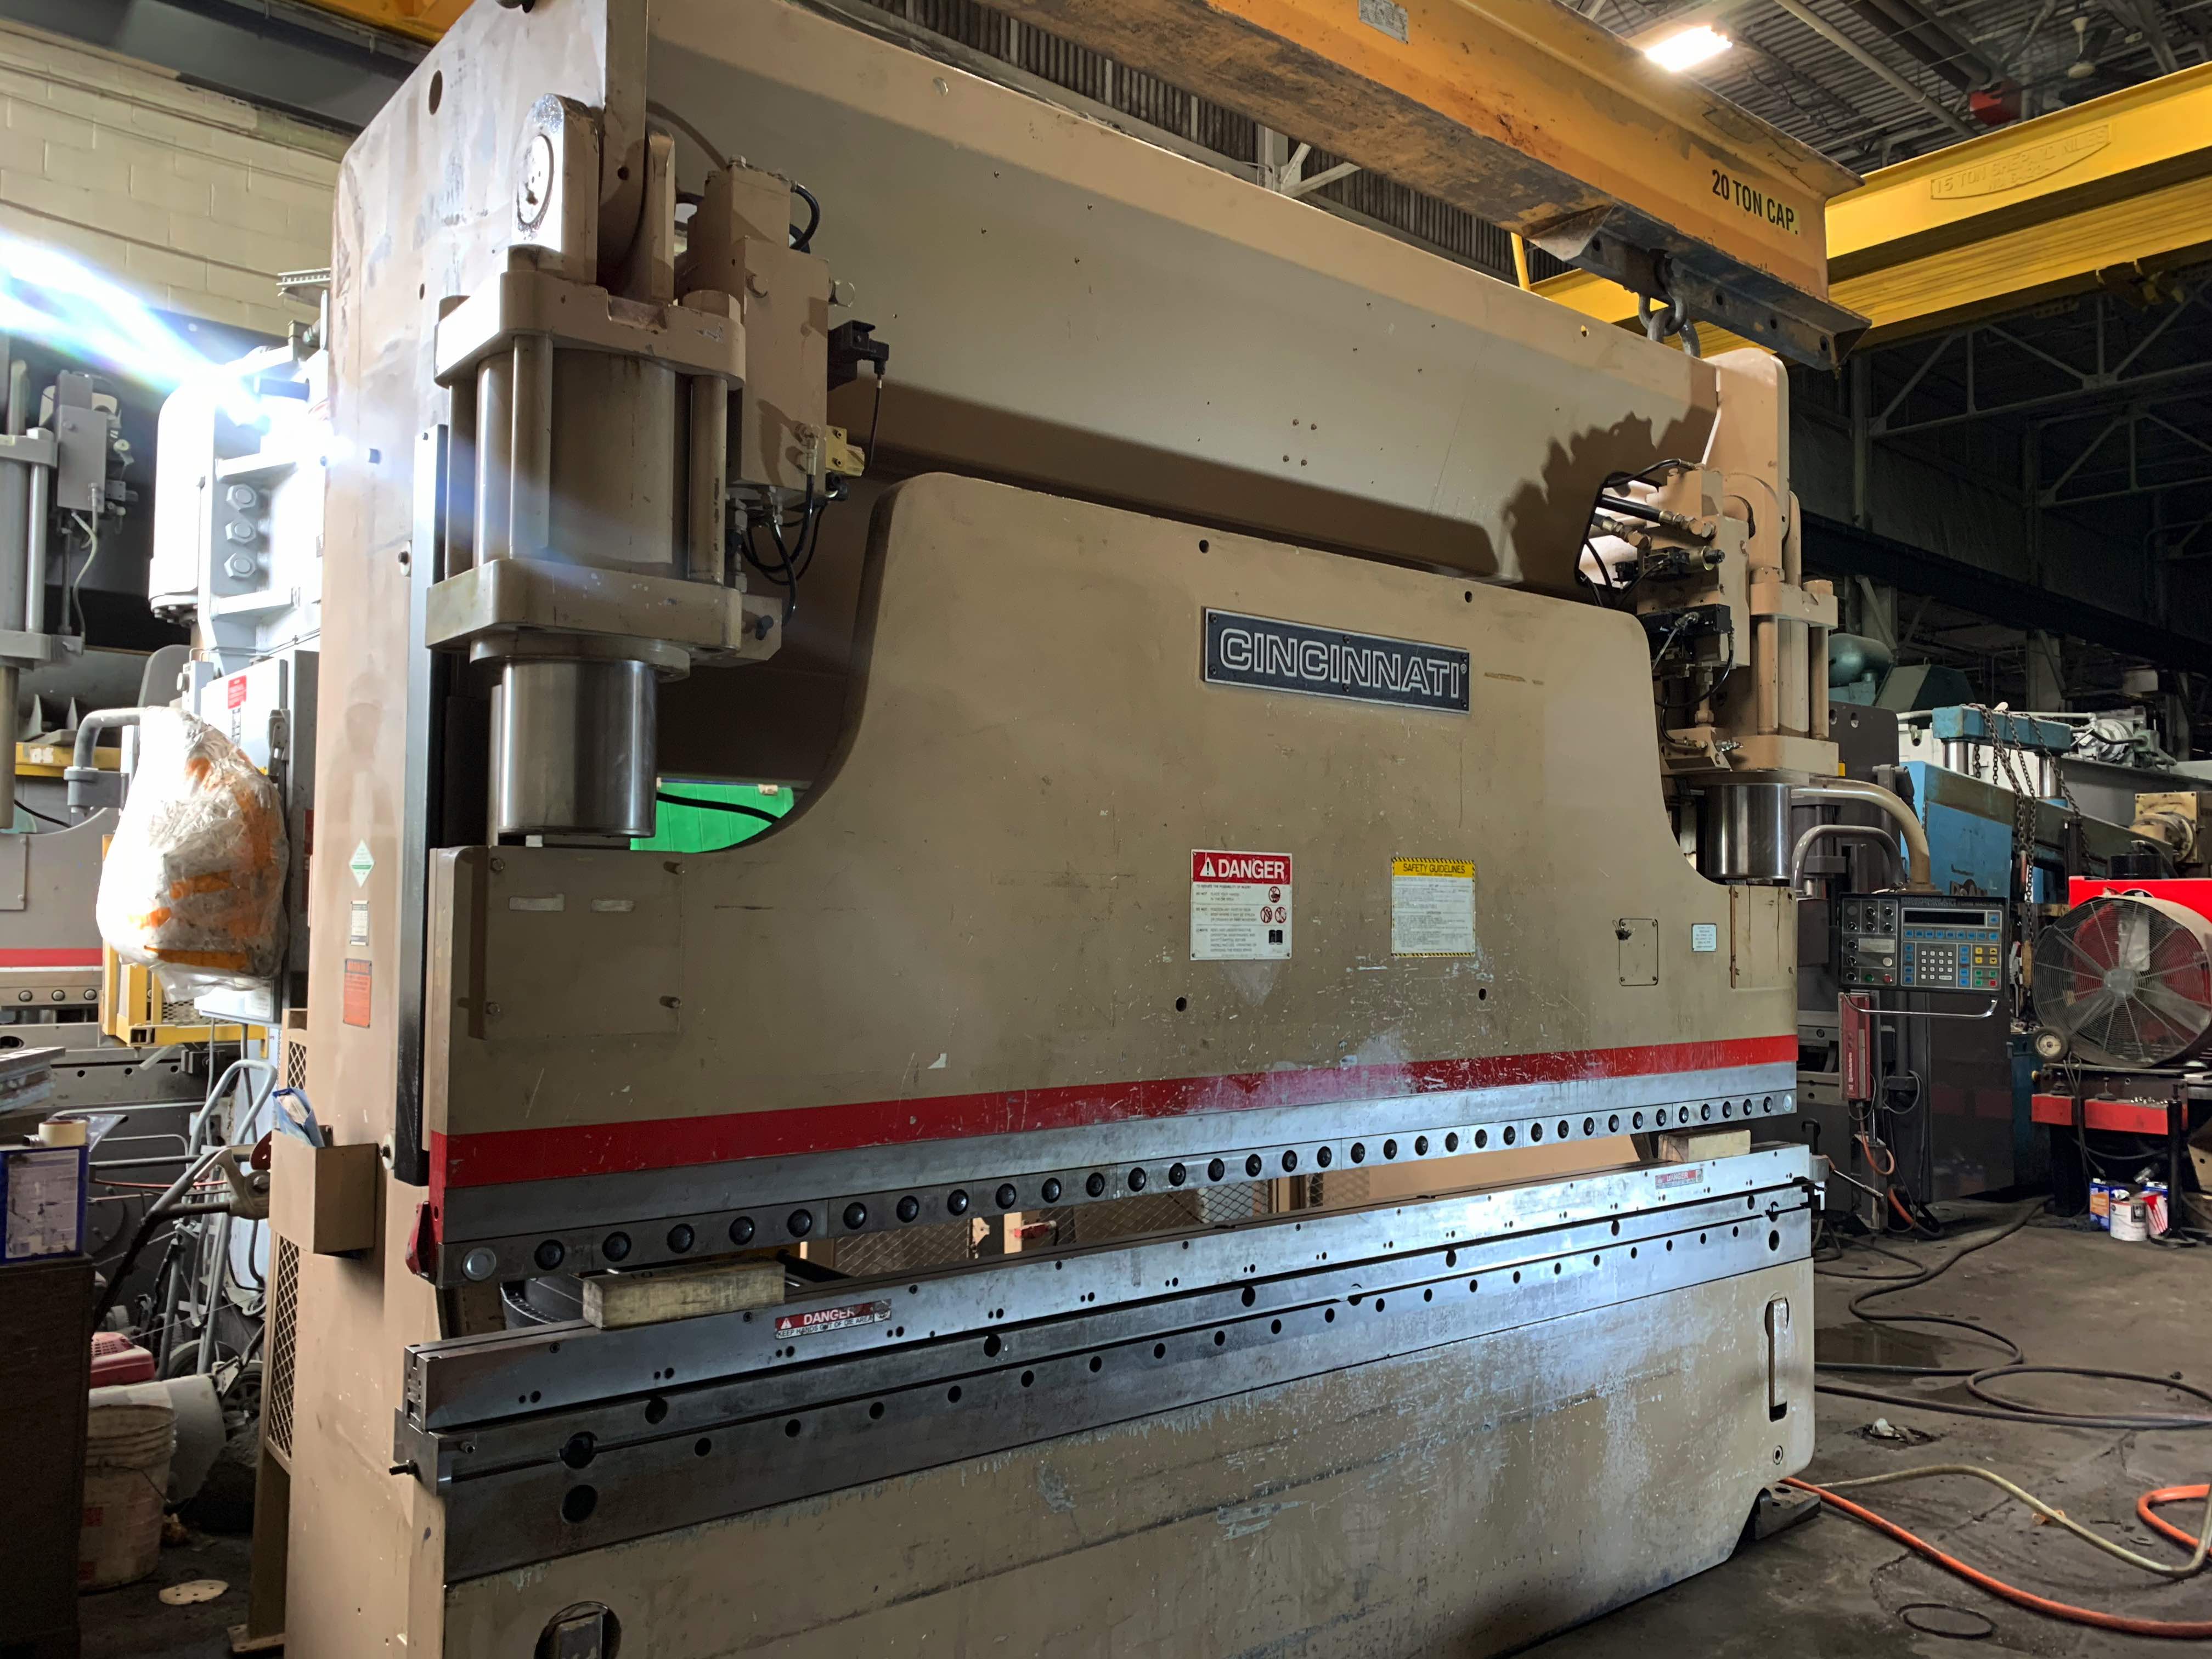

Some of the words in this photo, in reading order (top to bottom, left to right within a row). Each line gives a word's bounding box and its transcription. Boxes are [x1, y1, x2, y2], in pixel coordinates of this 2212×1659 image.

[1712, 170, 1730, 200] 20
[1733, 180, 1763, 217] TON
[1767, 198, 1798, 235] CAP.
[1218, 859, 1285, 879] DANGER
[1403, 863, 1427, 873] SAFETY
[1429, 864, 1465, 874] GUIDELINES
[796, 1325, 819, 1334] HANDS
[820, 1322, 833, 1331] OT
[855, 1316, 873, 1324] AREA
[803, 1306, 855, 1325] DANGER
